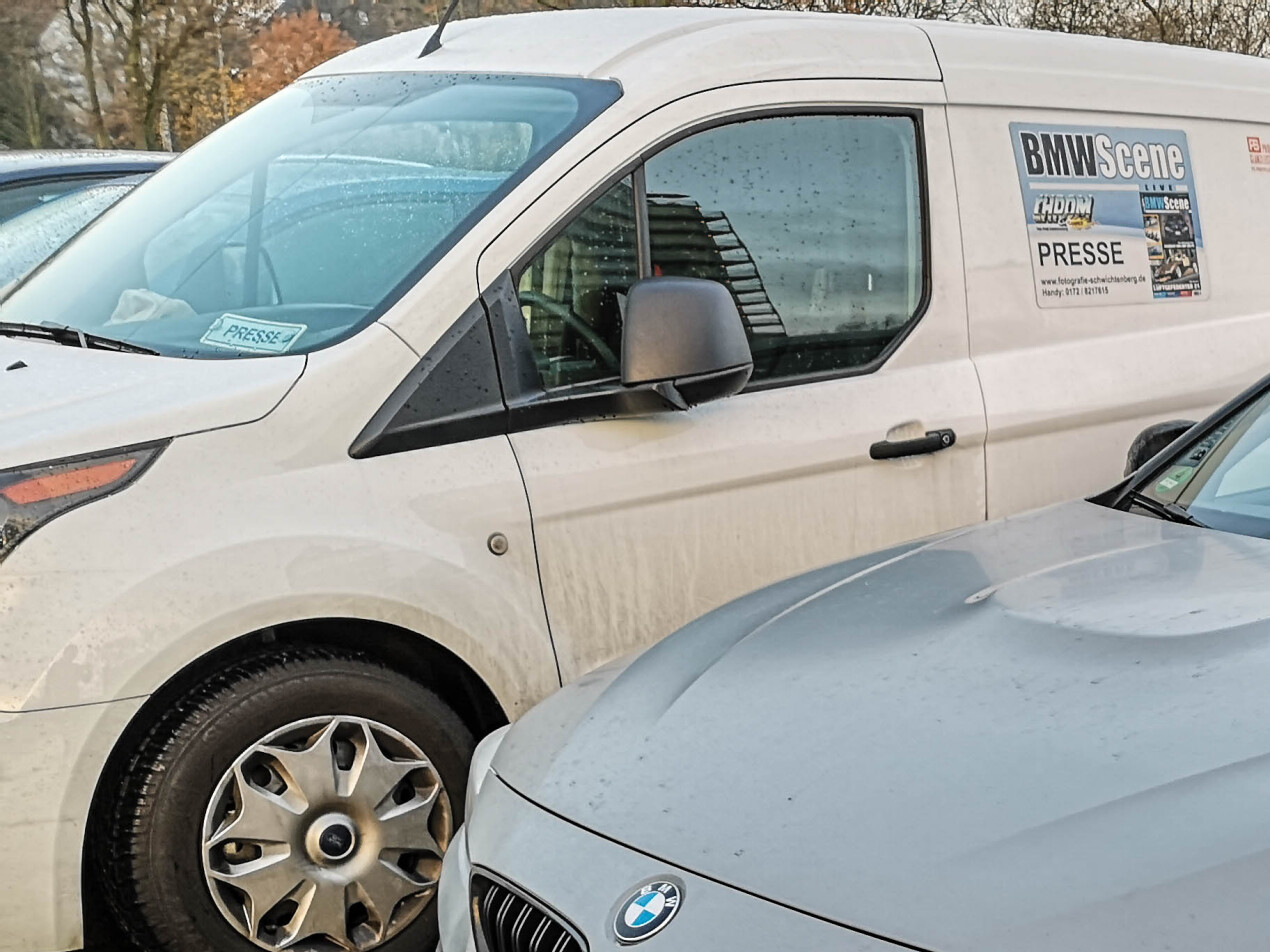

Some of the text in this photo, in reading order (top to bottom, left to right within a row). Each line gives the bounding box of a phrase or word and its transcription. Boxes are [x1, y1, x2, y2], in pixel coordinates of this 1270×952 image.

[1020, 132, 1186, 179] BMWScene
[1037, 241, 1124, 266] PRESSE
[223, 324, 281, 344] PRESSE
[641, 883, 677, 907] BMW
